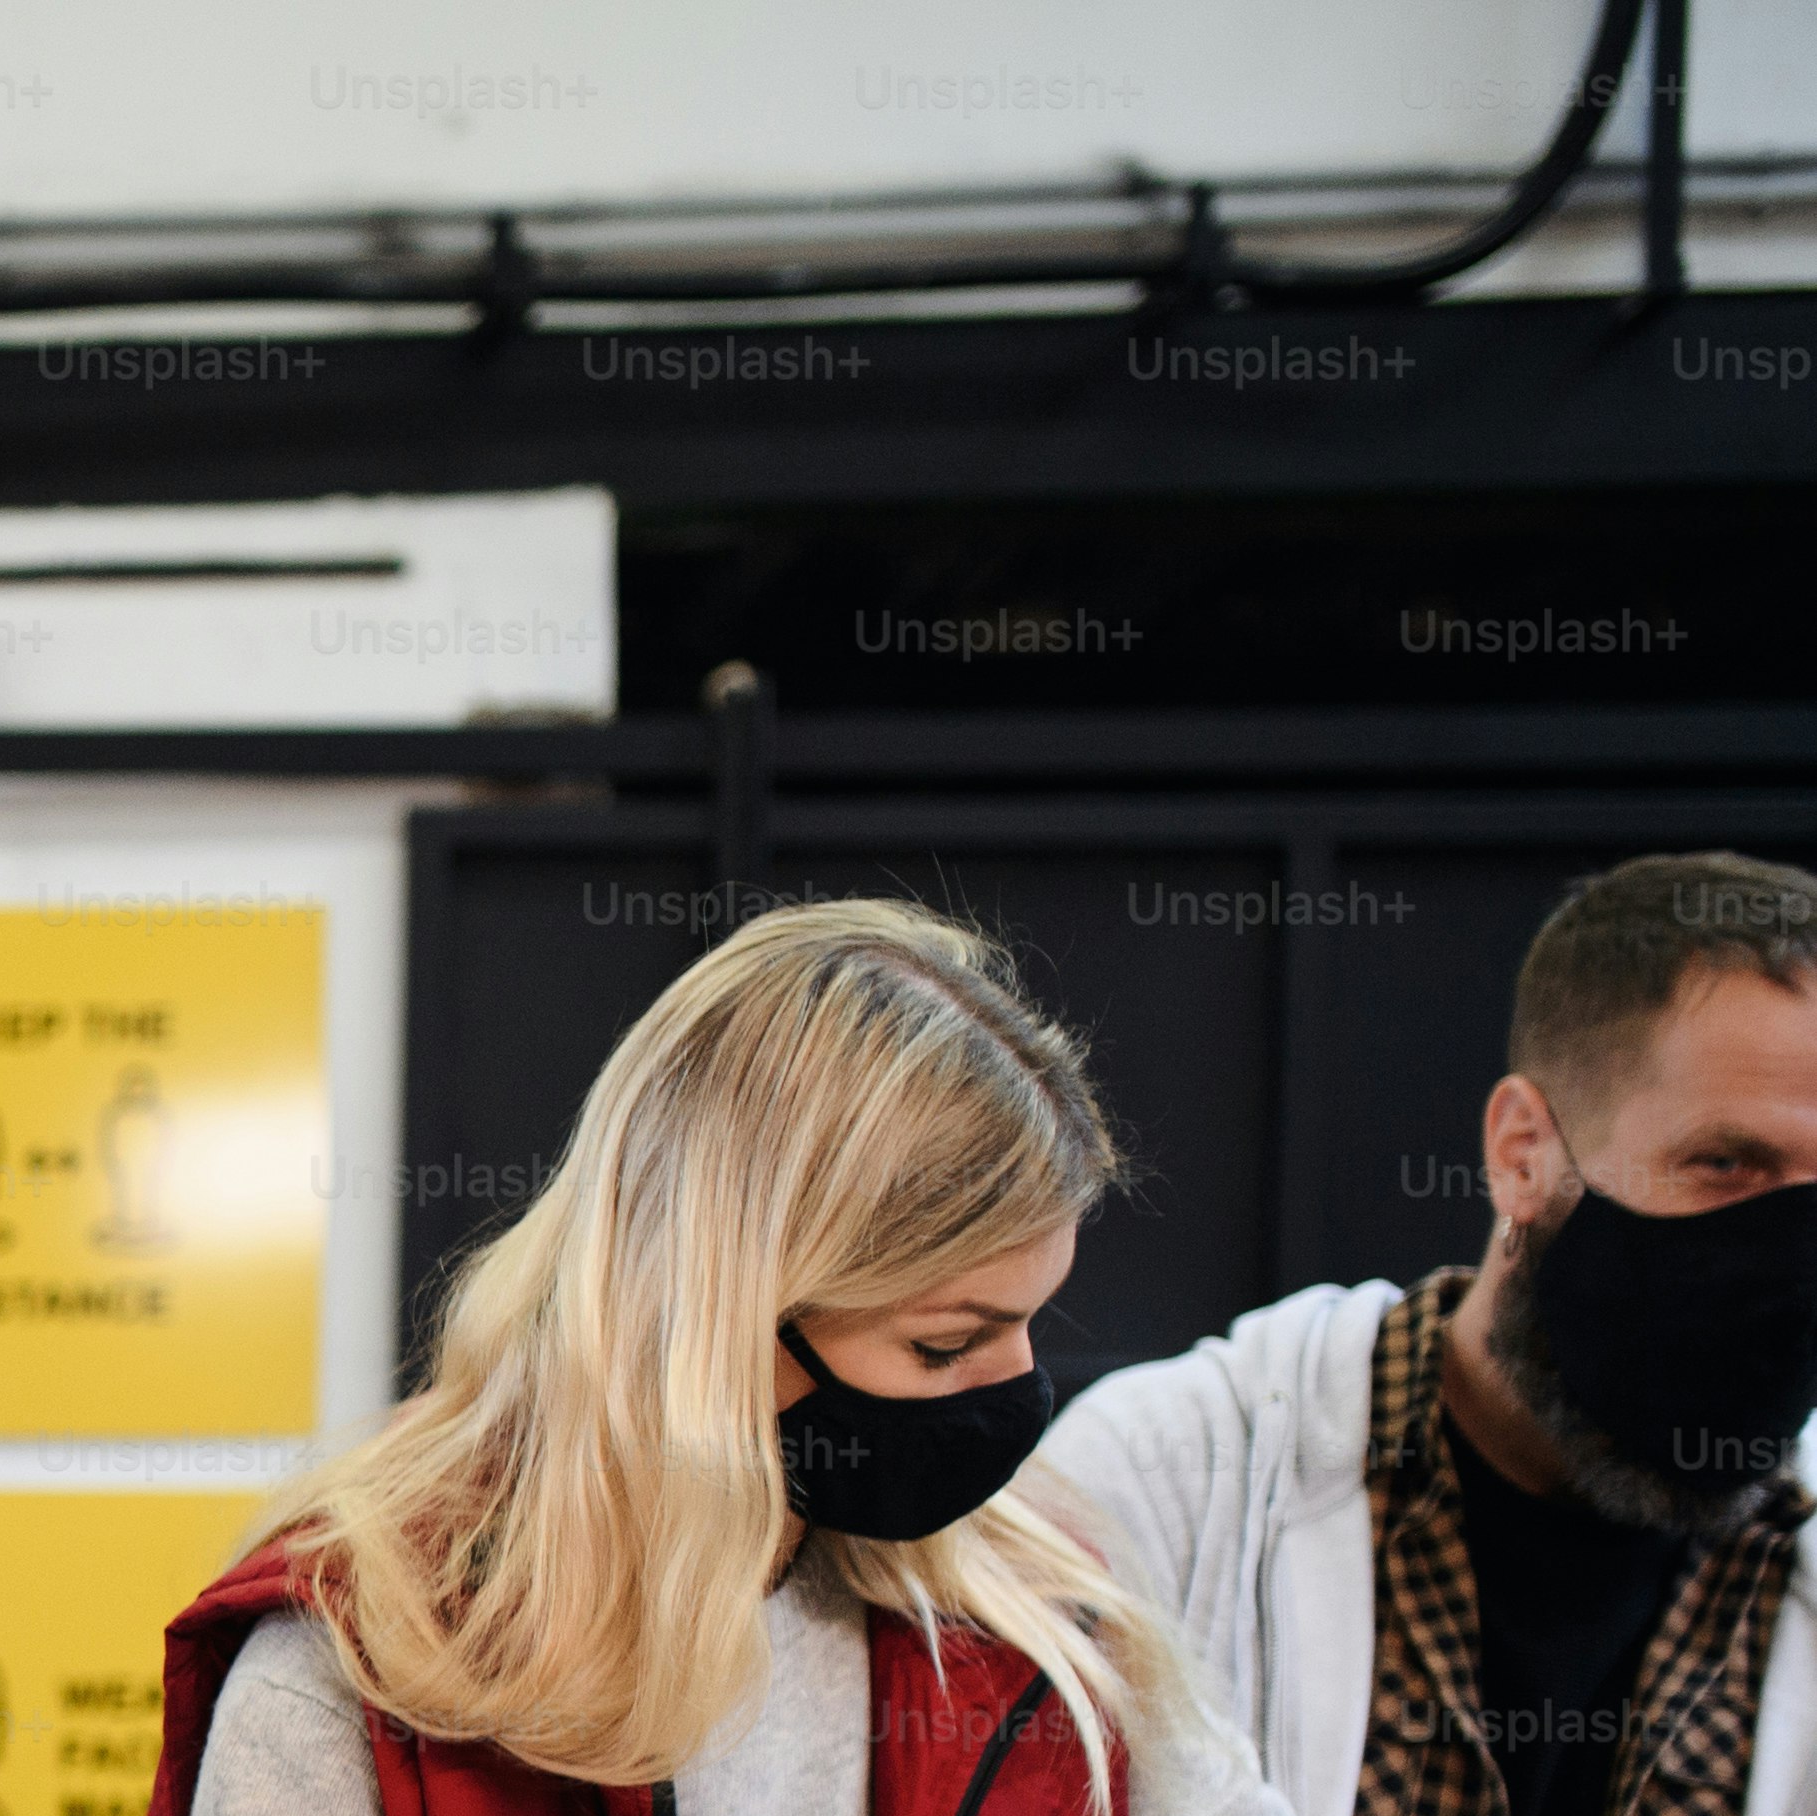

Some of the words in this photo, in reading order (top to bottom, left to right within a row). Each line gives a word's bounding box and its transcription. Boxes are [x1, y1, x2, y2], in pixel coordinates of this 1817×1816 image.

[81, 1003, 169, 1044] THE
[61, 1679, 165, 1716] WEA
[61, 1735, 163, 1775] FAC
